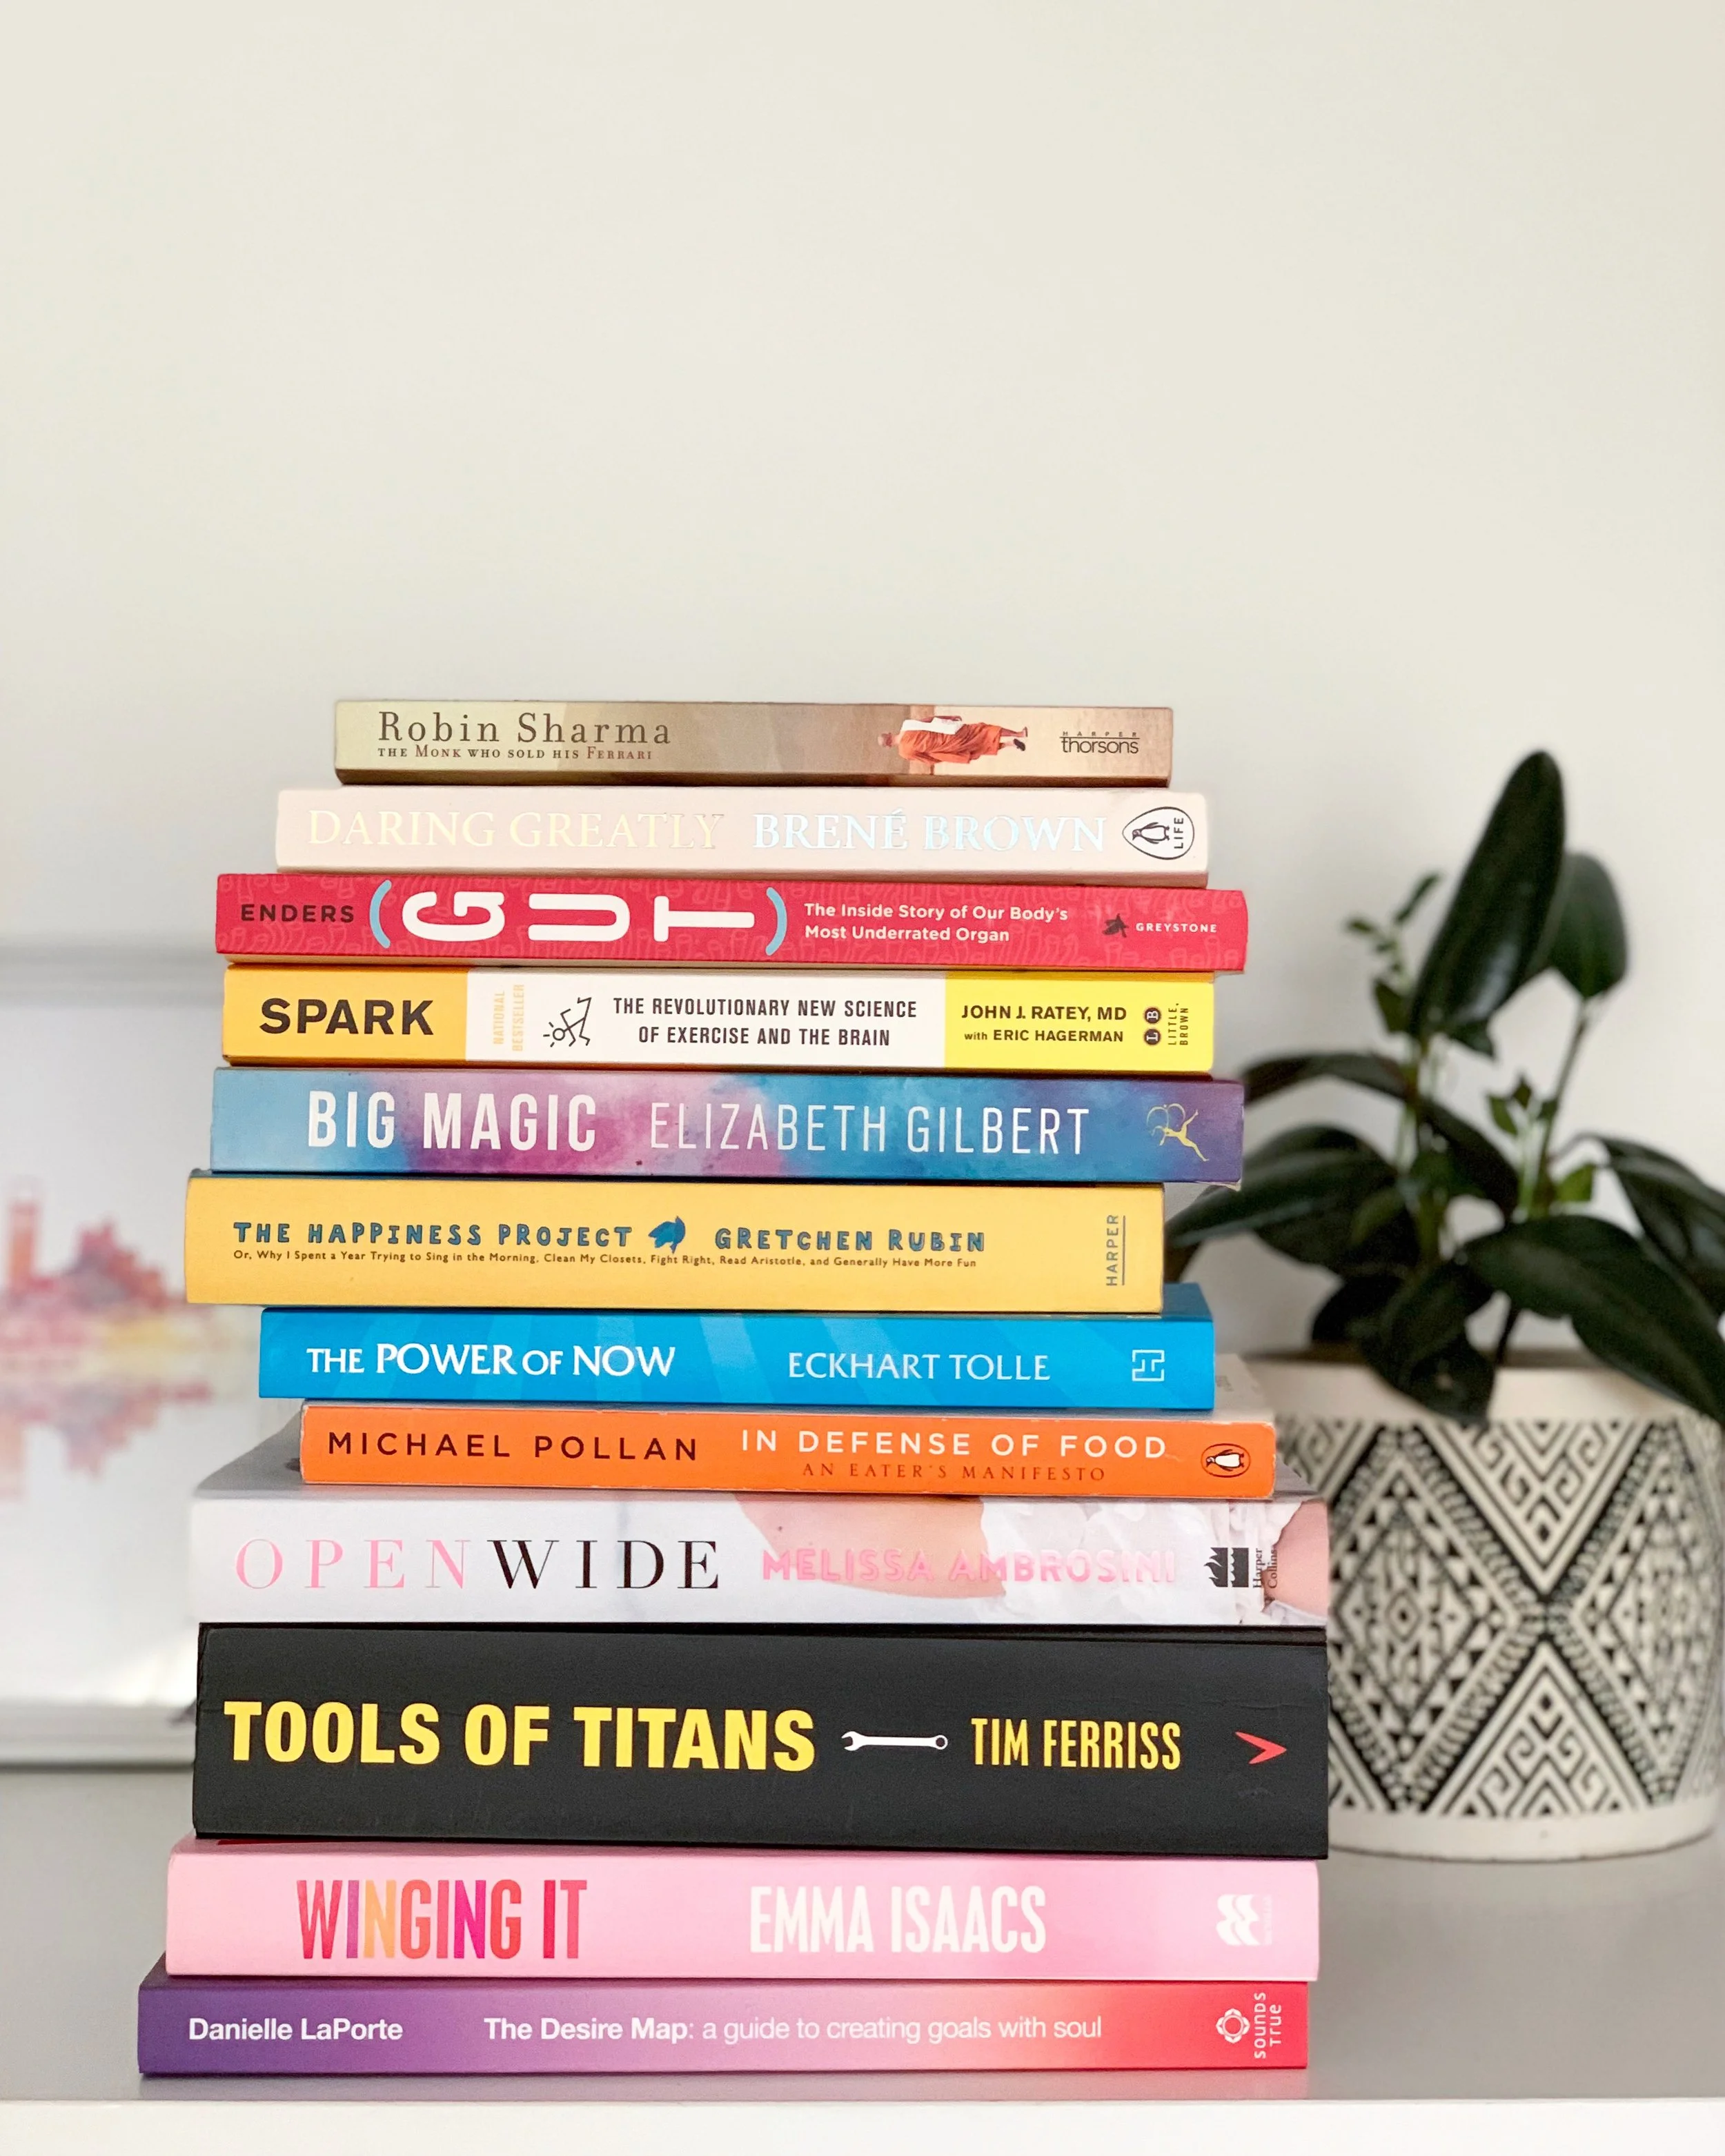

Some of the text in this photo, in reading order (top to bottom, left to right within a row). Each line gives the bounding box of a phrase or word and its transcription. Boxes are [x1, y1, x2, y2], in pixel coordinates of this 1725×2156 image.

[378, 711, 671, 744] Robin Sharma
[378, 748, 408, 758] THE
[468, 749, 502, 758] WHO
[507, 749, 546, 759] SOLD
[553, 749, 580, 760] HIS
[1061, 738, 1139, 754] thorsons
[308, 809, 1107, 852] DARING GREATLY BRENÉ BROWN
[1174, 818, 1184, 849] LIFE
[240, 904, 355, 923] ENDERS
[804, 902, 836, 918] The
[840, 902, 894, 918] Inside
[898, 903, 944, 921] Story
[949, 904, 968, 919] of
[972, 905, 1005, 920] Our
[1135, 922, 1218, 933] GREYSTONE
[805, 925, 1010, 945] Most Underrated Organ
[258, 998, 435, 1036] SPARK
[493, 990, 505, 1045] NATIONAL
[512, 985, 524, 1051] BESTSELLER
[613, 997, 917, 1018] THE REVOLUTIONARY NEW SCIENCE
[961, 1005, 1127, 1022] JOHN J. RATEY, MD
[638, 1027, 890, 1047] OF EXERCISE AND THE BRAIN
[964, 1030, 1124, 1043] with ERIC HAGERMAN
[1167, 1003, 1179, 1045] LITTLE,
[1179, 1008, 1189, 1045] BROWN
[307, 1090, 1089, 1155] BIG MAGIC ELIZABETH GILBERT
[233, 1222, 985, 1252] THE HAPPINESS PROJECT GRETCHEN RUBIN
[1105, 1214, 1119, 1286] HARPER
[233, 1249, 976, 1268] Or, Why I Spent a Year Trying to Sing in the Morning, Clean My Closets, Fight Right, Read Aristotle, and Generally Have More Fun
[306, 1343, 1052, 1381] THE POWER OF NOW ECKHART TOLLE
[328, 1430, 1167, 1461] MICHAEL POLLAN IN DEFENSE OF FOOD
[802, 1463, 835, 1478] AN
[962, 1464, 1105, 1481] MANIFESTO
[761, 1548, 934, 1581] MELISSA
[950, 1549, 1176, 1583] AMBROSINI
[1252, 1547, 1265, 1588] Harper
[1268, 1550, 1278, 1589] Collins
[224, 1700, 1181, 1772] TOOLS OF TITANS TIM FERRISS
[296, 1879, 1047, 1959] WINGING IT EMMA ISAACS
[188, 2015, 1102, 2046] Danielle LaPorte The Desire Map: a guide to creating goals with soul
[1269, 2004, 1282, 2048] True
